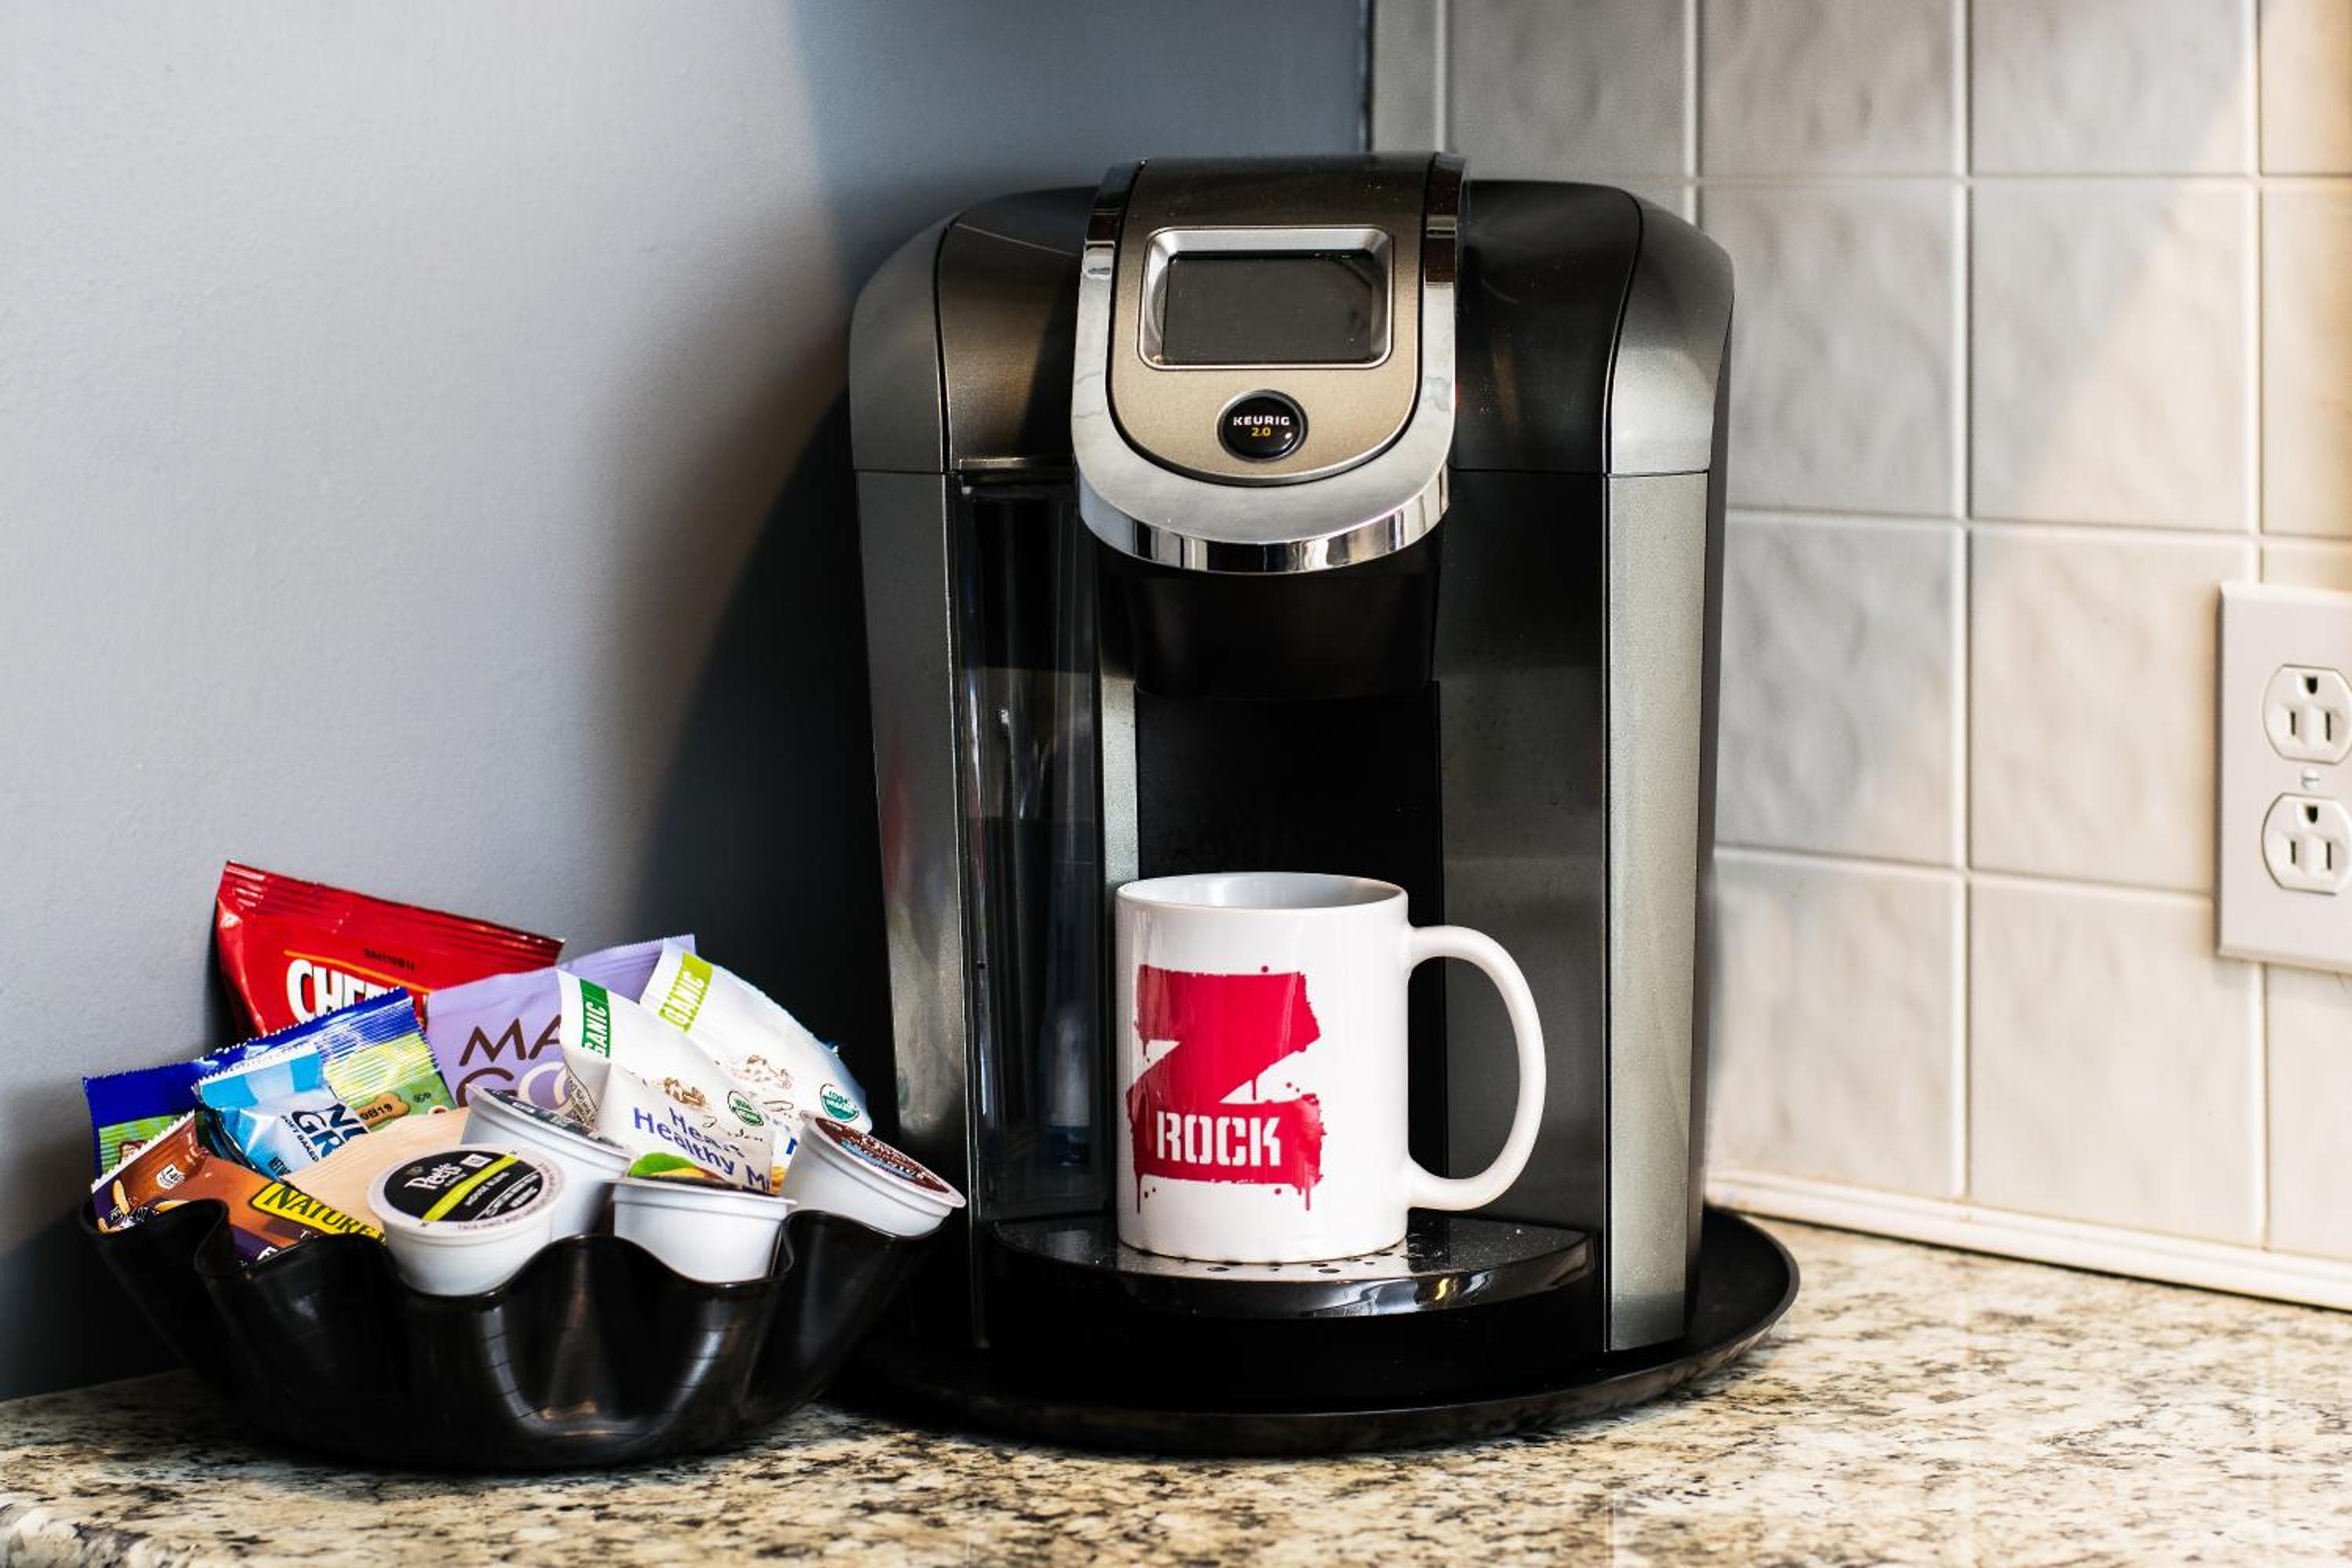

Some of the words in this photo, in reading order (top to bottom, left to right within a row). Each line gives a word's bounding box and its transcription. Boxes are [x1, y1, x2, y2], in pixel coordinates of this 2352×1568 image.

[1232, 415, 1290, 426] KEURIG
[1251, 426, 1272, 437] 2.0
[633, 1106, 735, 1176] Healthy
[1156, 1112, 1283, 1167] ROCK
